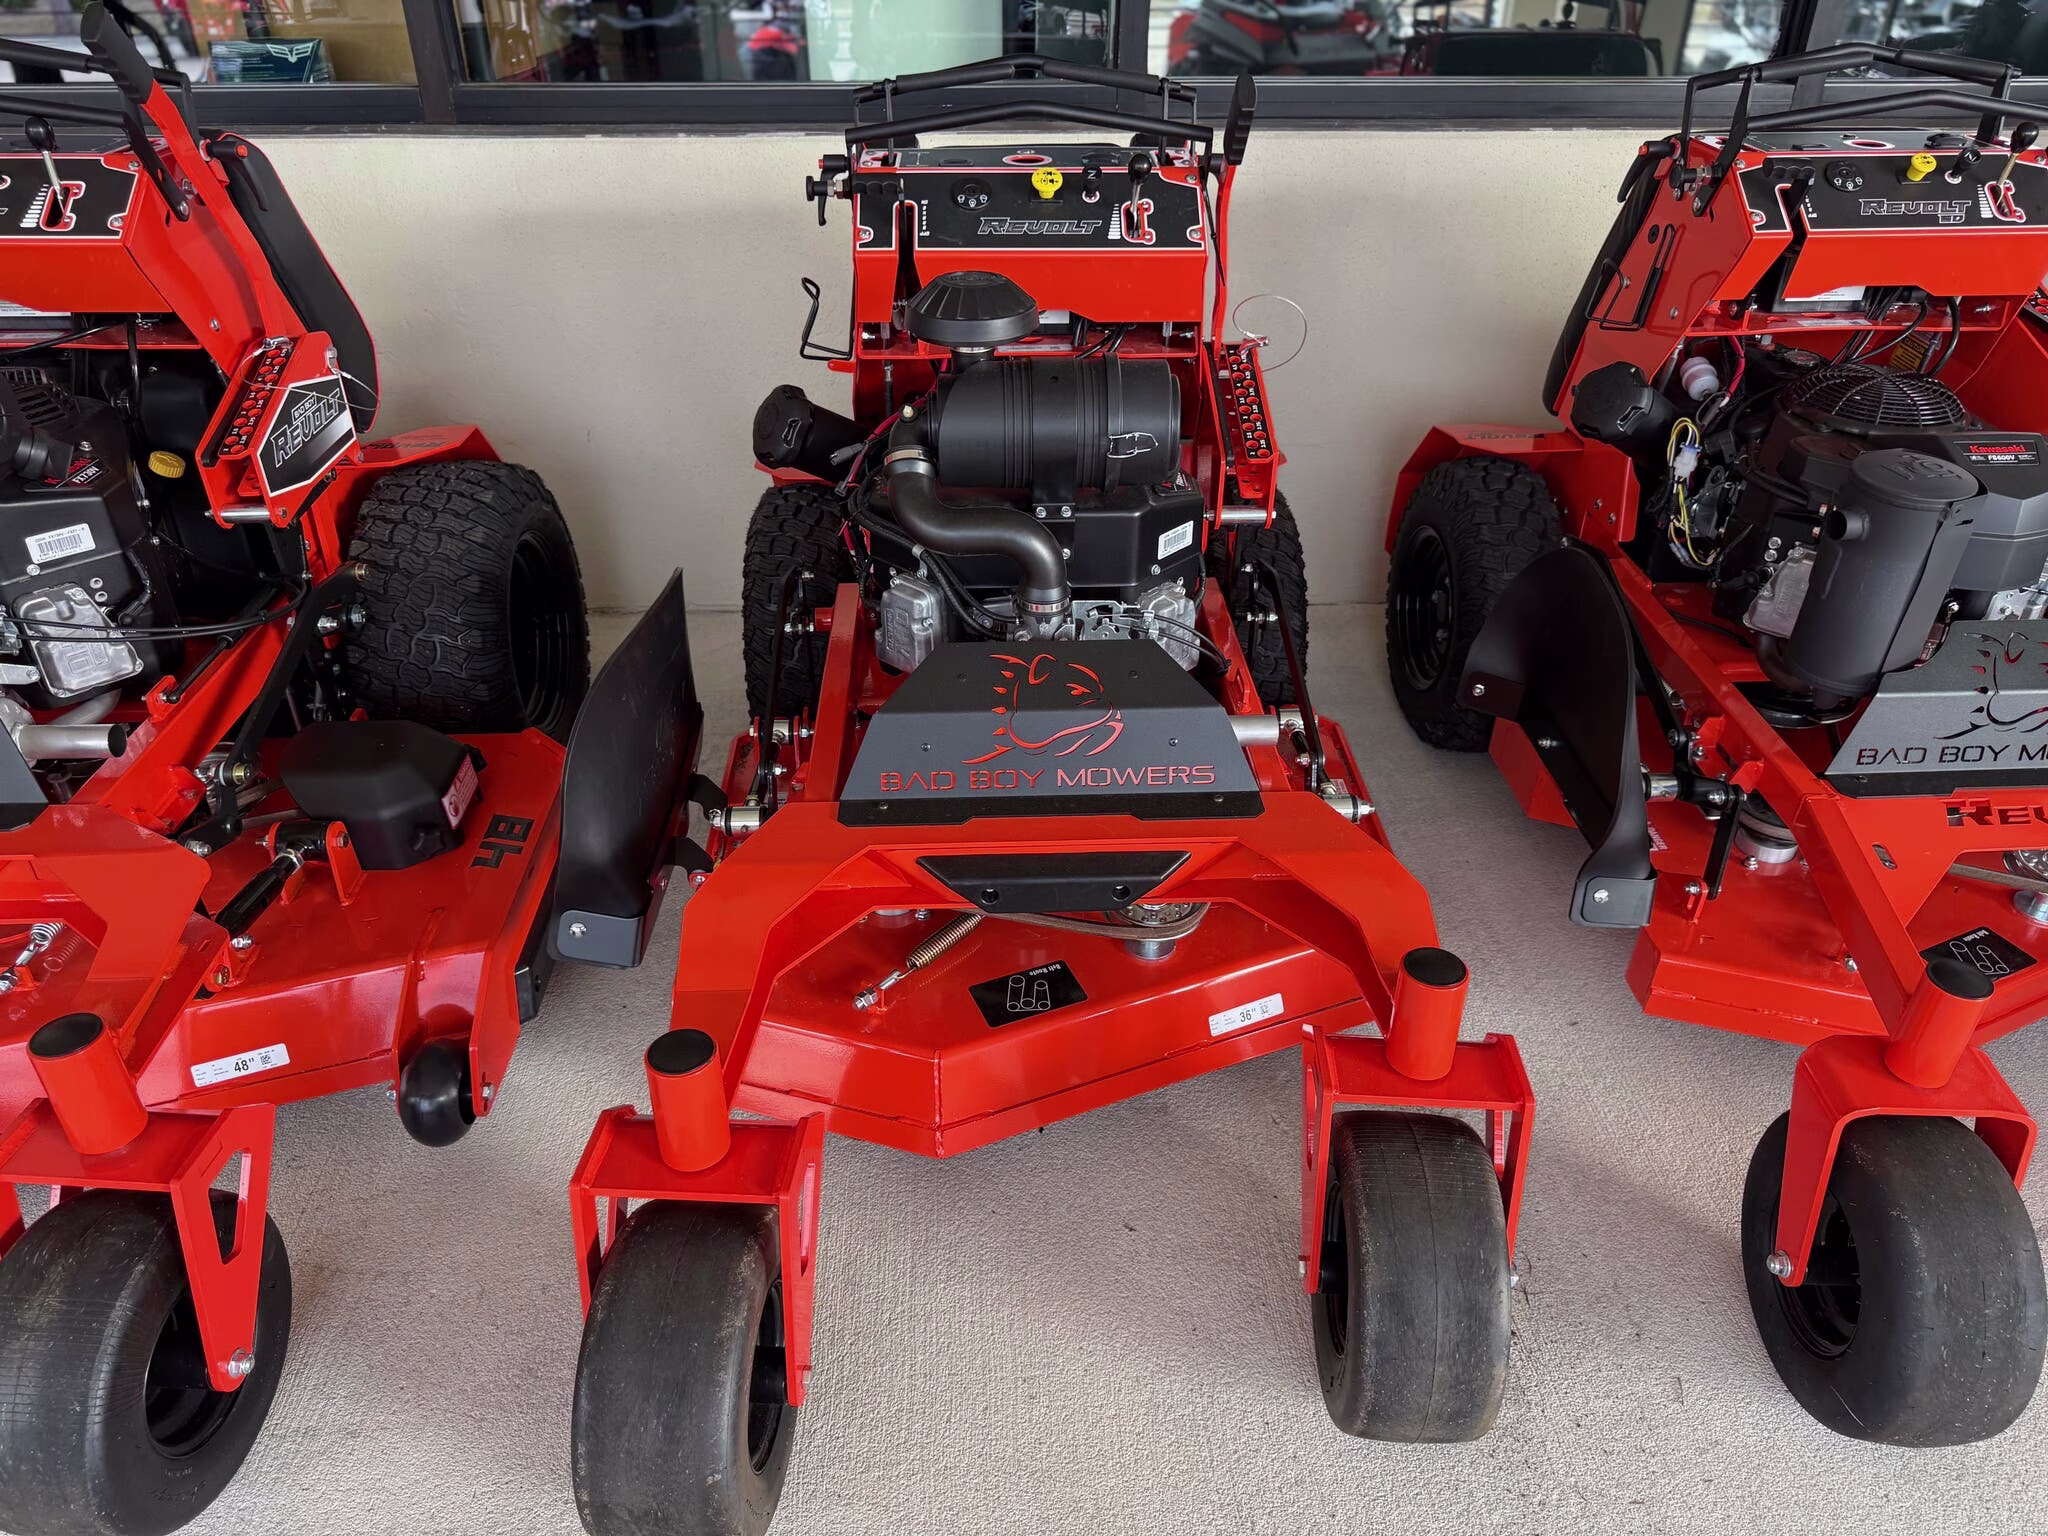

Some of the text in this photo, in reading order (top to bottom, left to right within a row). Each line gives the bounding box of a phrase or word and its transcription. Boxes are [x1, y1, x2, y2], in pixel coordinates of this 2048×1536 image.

[1859, 198, 1971, 215] REVOLT
[977, 216, 1102, 235] REVOLT
[294, 397, 315, 419] BAD BOY
[270, 388, 340, 468] REVOLT
[1969, 445, 2026, 453] Kawasaki
[1855, 747, 1928, 766] BAD
[1938, 744, 2011, 763] BOY
[880, 764, 1216, 792] BAD BOY MOWERS
[1239, 1007, 1256, 1023] 36"
[234, 1057, 255, 1072] 48"
